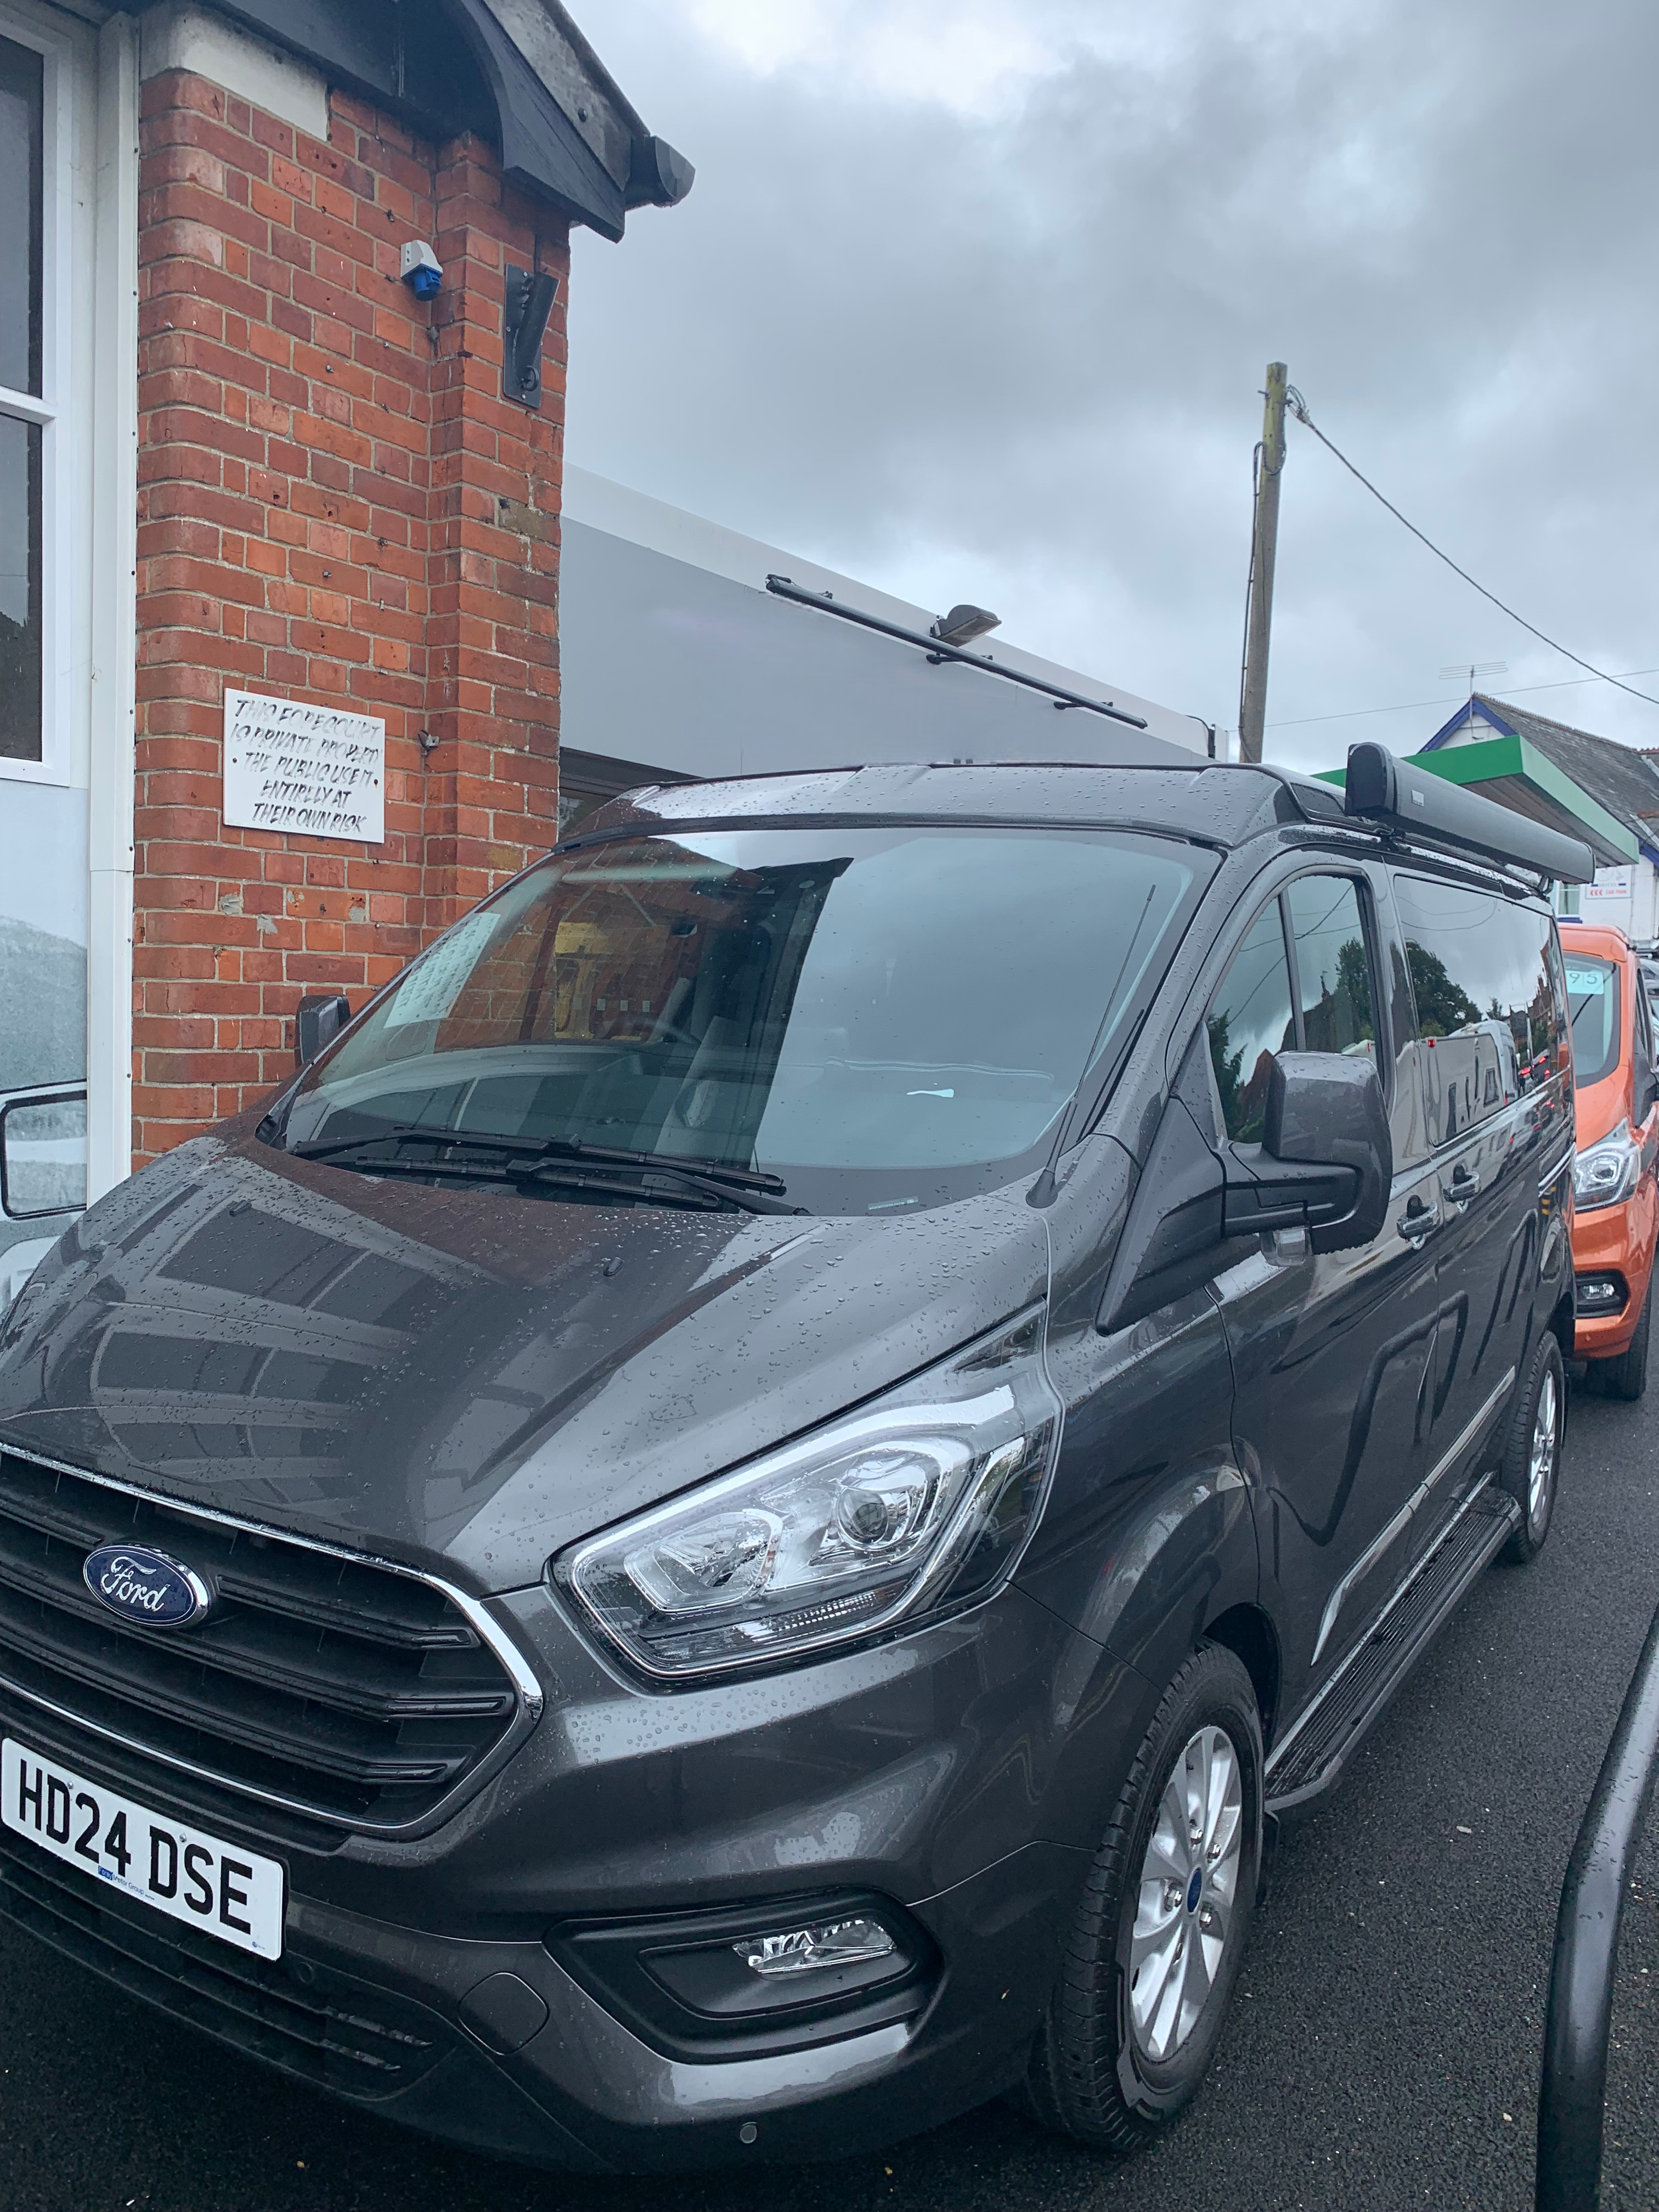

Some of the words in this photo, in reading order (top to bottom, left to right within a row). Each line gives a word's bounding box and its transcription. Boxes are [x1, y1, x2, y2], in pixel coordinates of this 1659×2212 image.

[235, 699, 277, 722] THIS
[276, 707, 381, 742] FORECOURT
[230, 723, 251, 742] IS
[249, 726, 317, 754] PRIVATE
[245, 752, 273, 772] THE
[274, 755, 330, 782] PUBLIC
[330, 764, 360, 785] USE
[259, 779, 334, 806] ENTIRELY
[330, 789, 352, 808] AT
[252, 803, 297, 826] THEIR
[296, 808, 331, 830] OWN
[330, 812, 367, 834] RISK
[100, 1556, 171, 1612] Ford
[19, 1758, 131, 1877] HD24
[149, 1825, 252, 1936] DSE
[128, 1882, 144, 1895] Group
